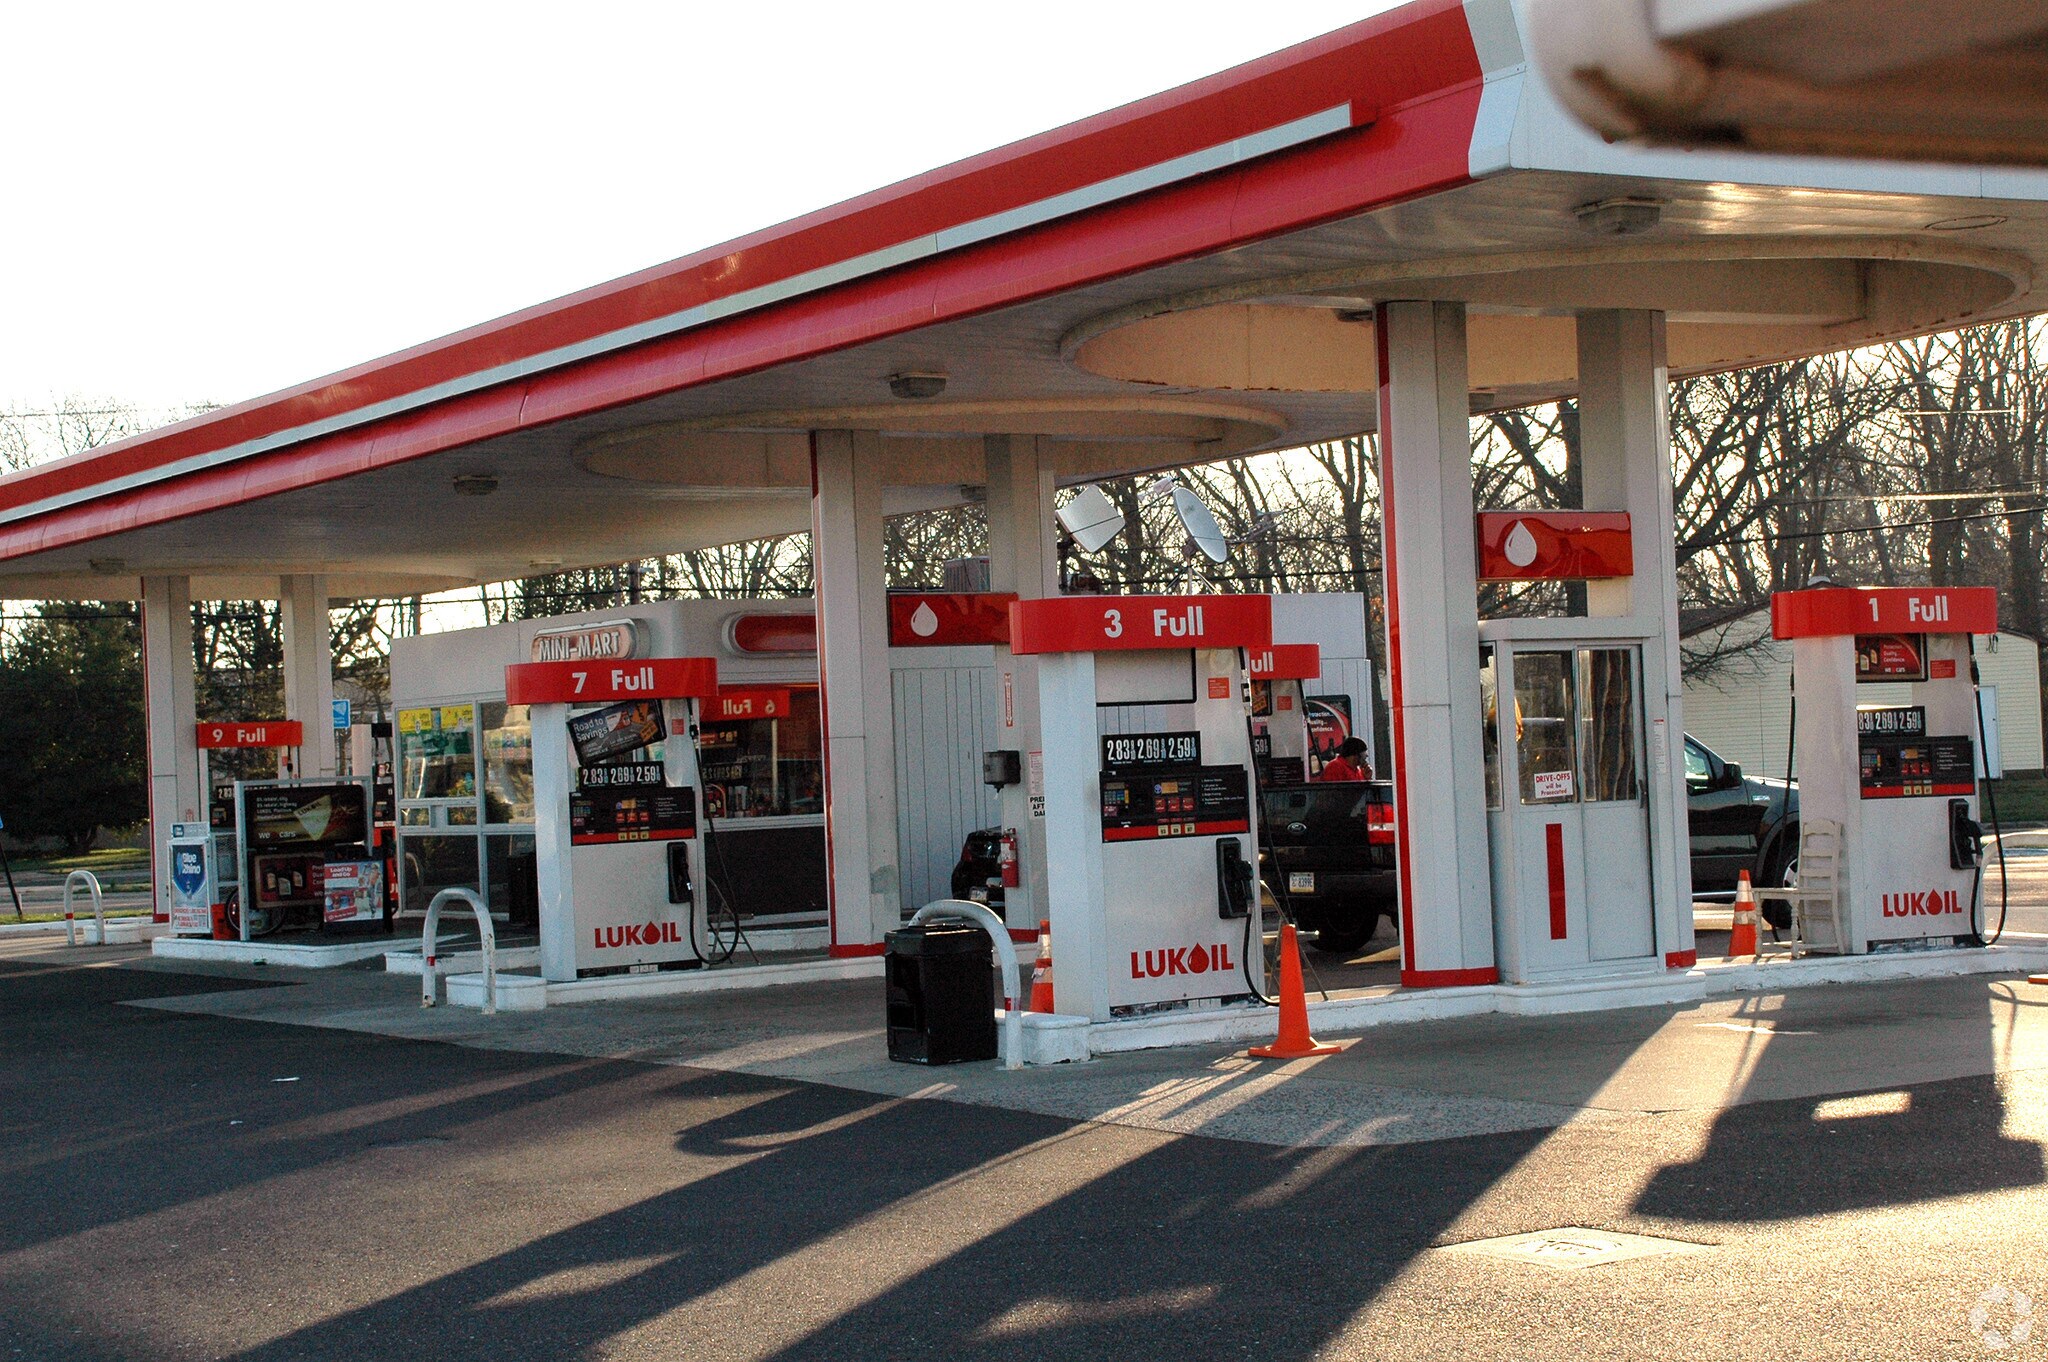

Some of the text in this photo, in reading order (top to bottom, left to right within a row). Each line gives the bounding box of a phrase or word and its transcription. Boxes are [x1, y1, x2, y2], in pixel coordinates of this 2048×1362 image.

[1868, 595, 1949, 622] 1 Full
[1104, 606, 1204, 639] 3 Full
[539, 631, 621, 661] MINI-MART
[1251, 651, 1274, 673] ull
[571, 667, 654, 694] 7 Full
[212, 727, 266, 744] 9 Full
[573, 717, 604, 733] Road to
[575, 726, 609, 743] Savings
[1535, 772, 1571, 783] DRIVE-OFFS
[182, 852, 197, 864] Blue
[1882, 888, 1963, 918] LUKOIL
[594, 920, 682, 949] LUKOIL
[1130, 942, 1234, 979] LUKOIL
